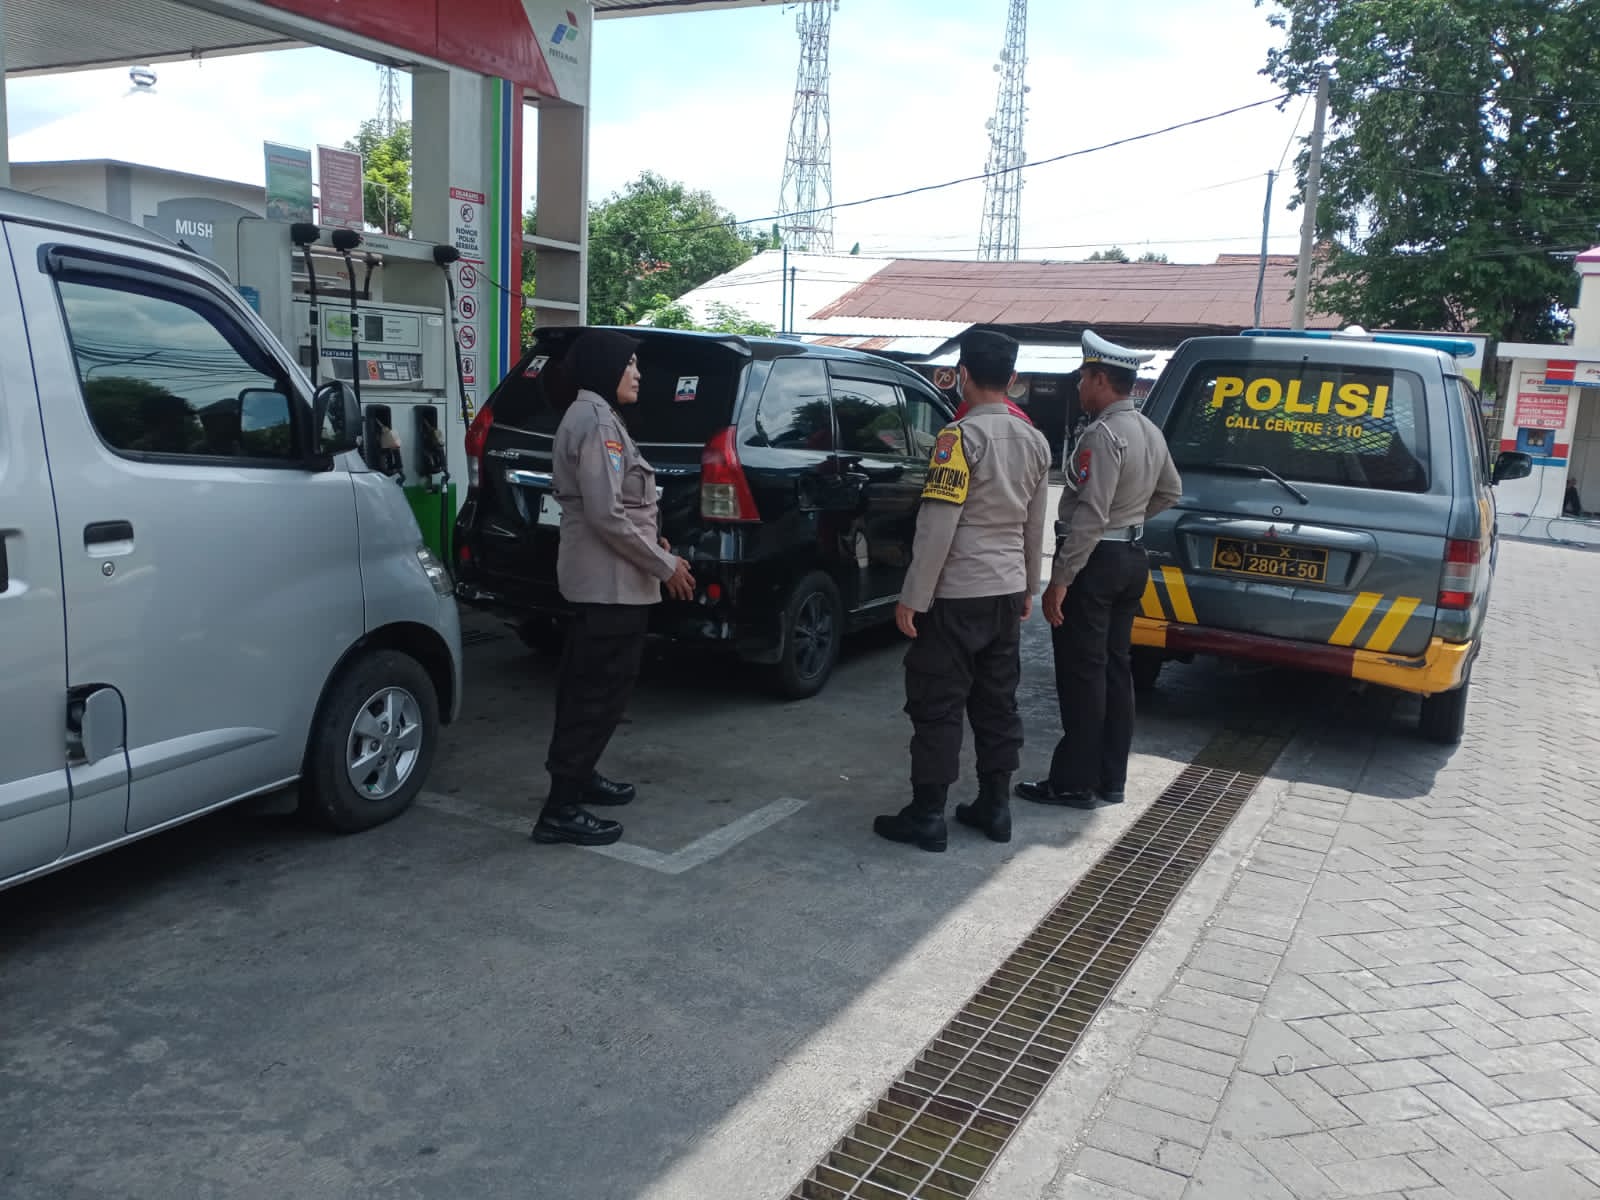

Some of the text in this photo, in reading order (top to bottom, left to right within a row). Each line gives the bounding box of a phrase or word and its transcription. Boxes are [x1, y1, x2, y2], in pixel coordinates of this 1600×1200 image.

[1211, 376, 1389, 419] POLISI
[1225, 415, 1261, 430] CALL
[1265, 418, 1323, 435] CENTRE
[1336, 425, 1362, 439] 110
[1280, 547, 1290, 558] X
[1247, 557, 1318, 578] 2801-50
